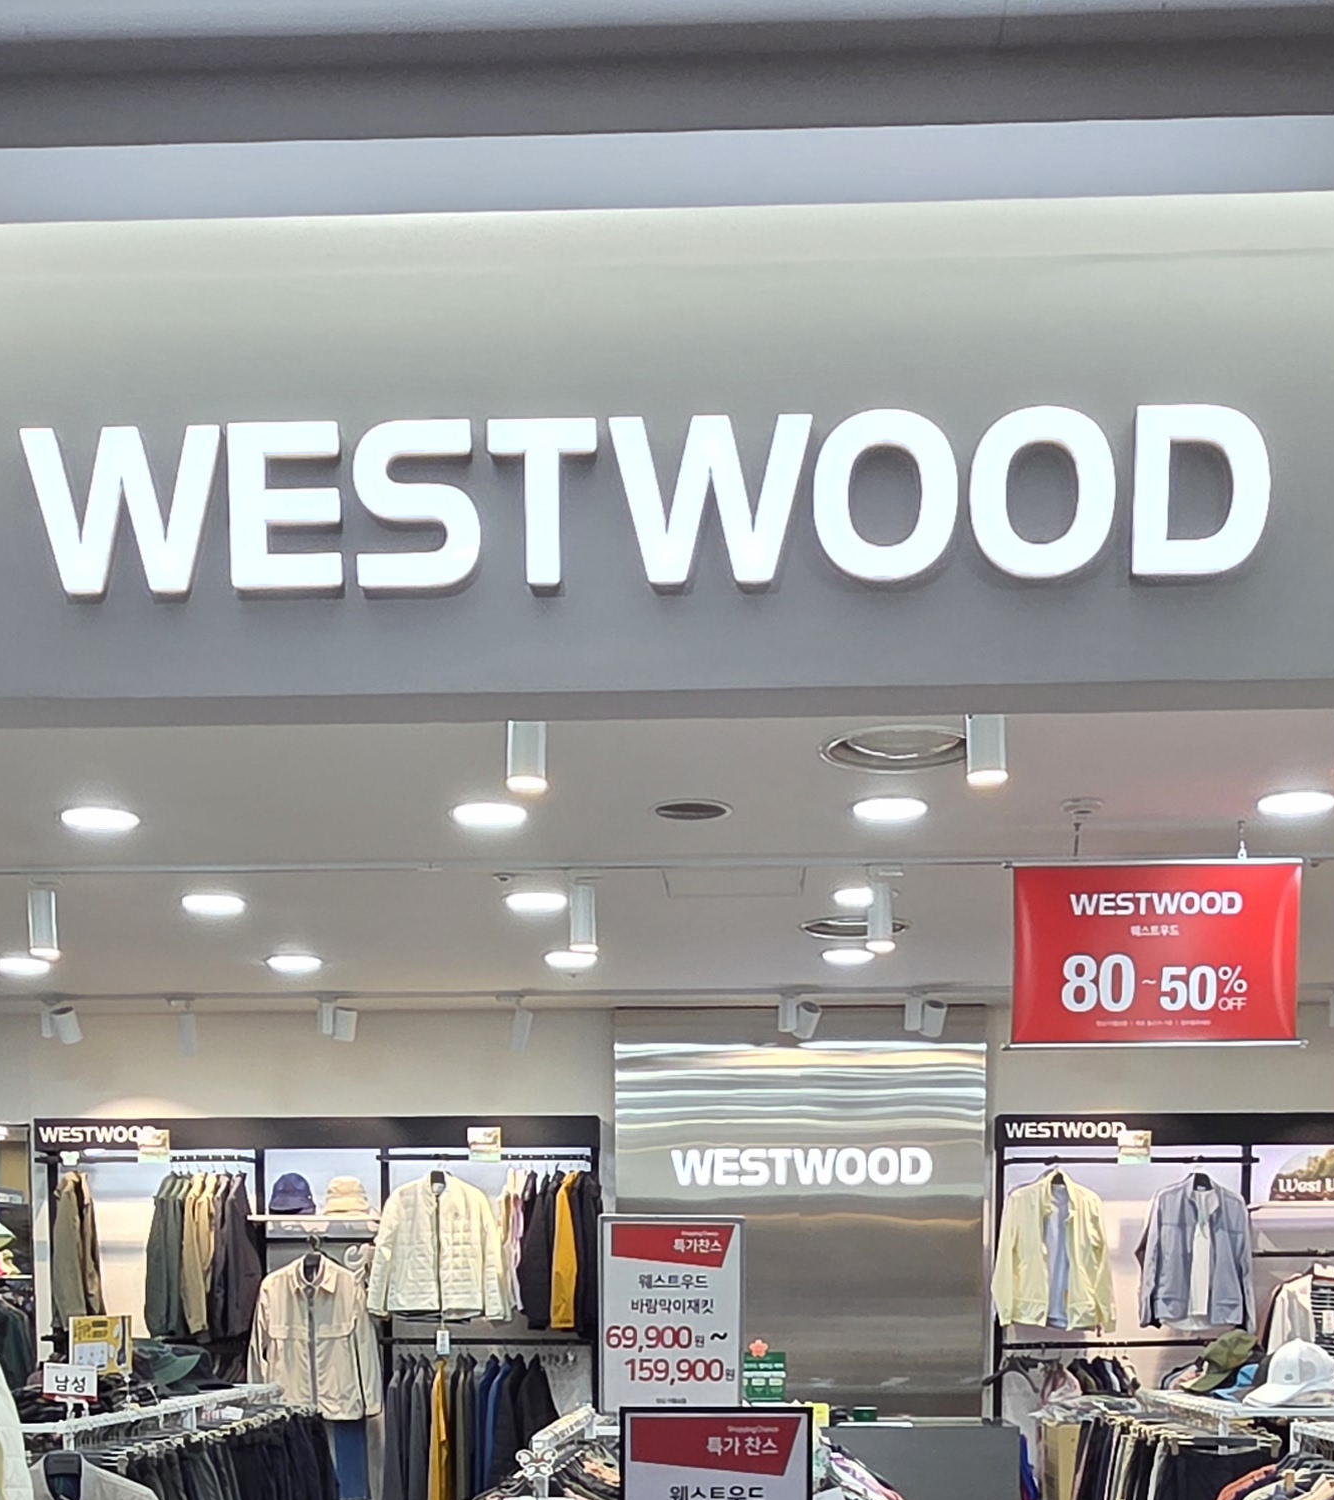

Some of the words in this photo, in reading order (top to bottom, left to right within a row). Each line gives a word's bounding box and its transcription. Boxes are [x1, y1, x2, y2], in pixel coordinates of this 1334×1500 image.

[19, 403, 1271, 597] WESTWOOD
[1069, 891, 1243, 916] WESTWOOD
[1061, 954, 1136, 1012] 80
[1218, 997, 1247, 1011] OFF
[670, 1147, 933, 1186] WESTWOOD
[638, 1273, 709, 1290] 웨스트우드
[630, 1298, 715, 1315] 바람막이재킷
[54, 1374, 86, 1393] 남성
